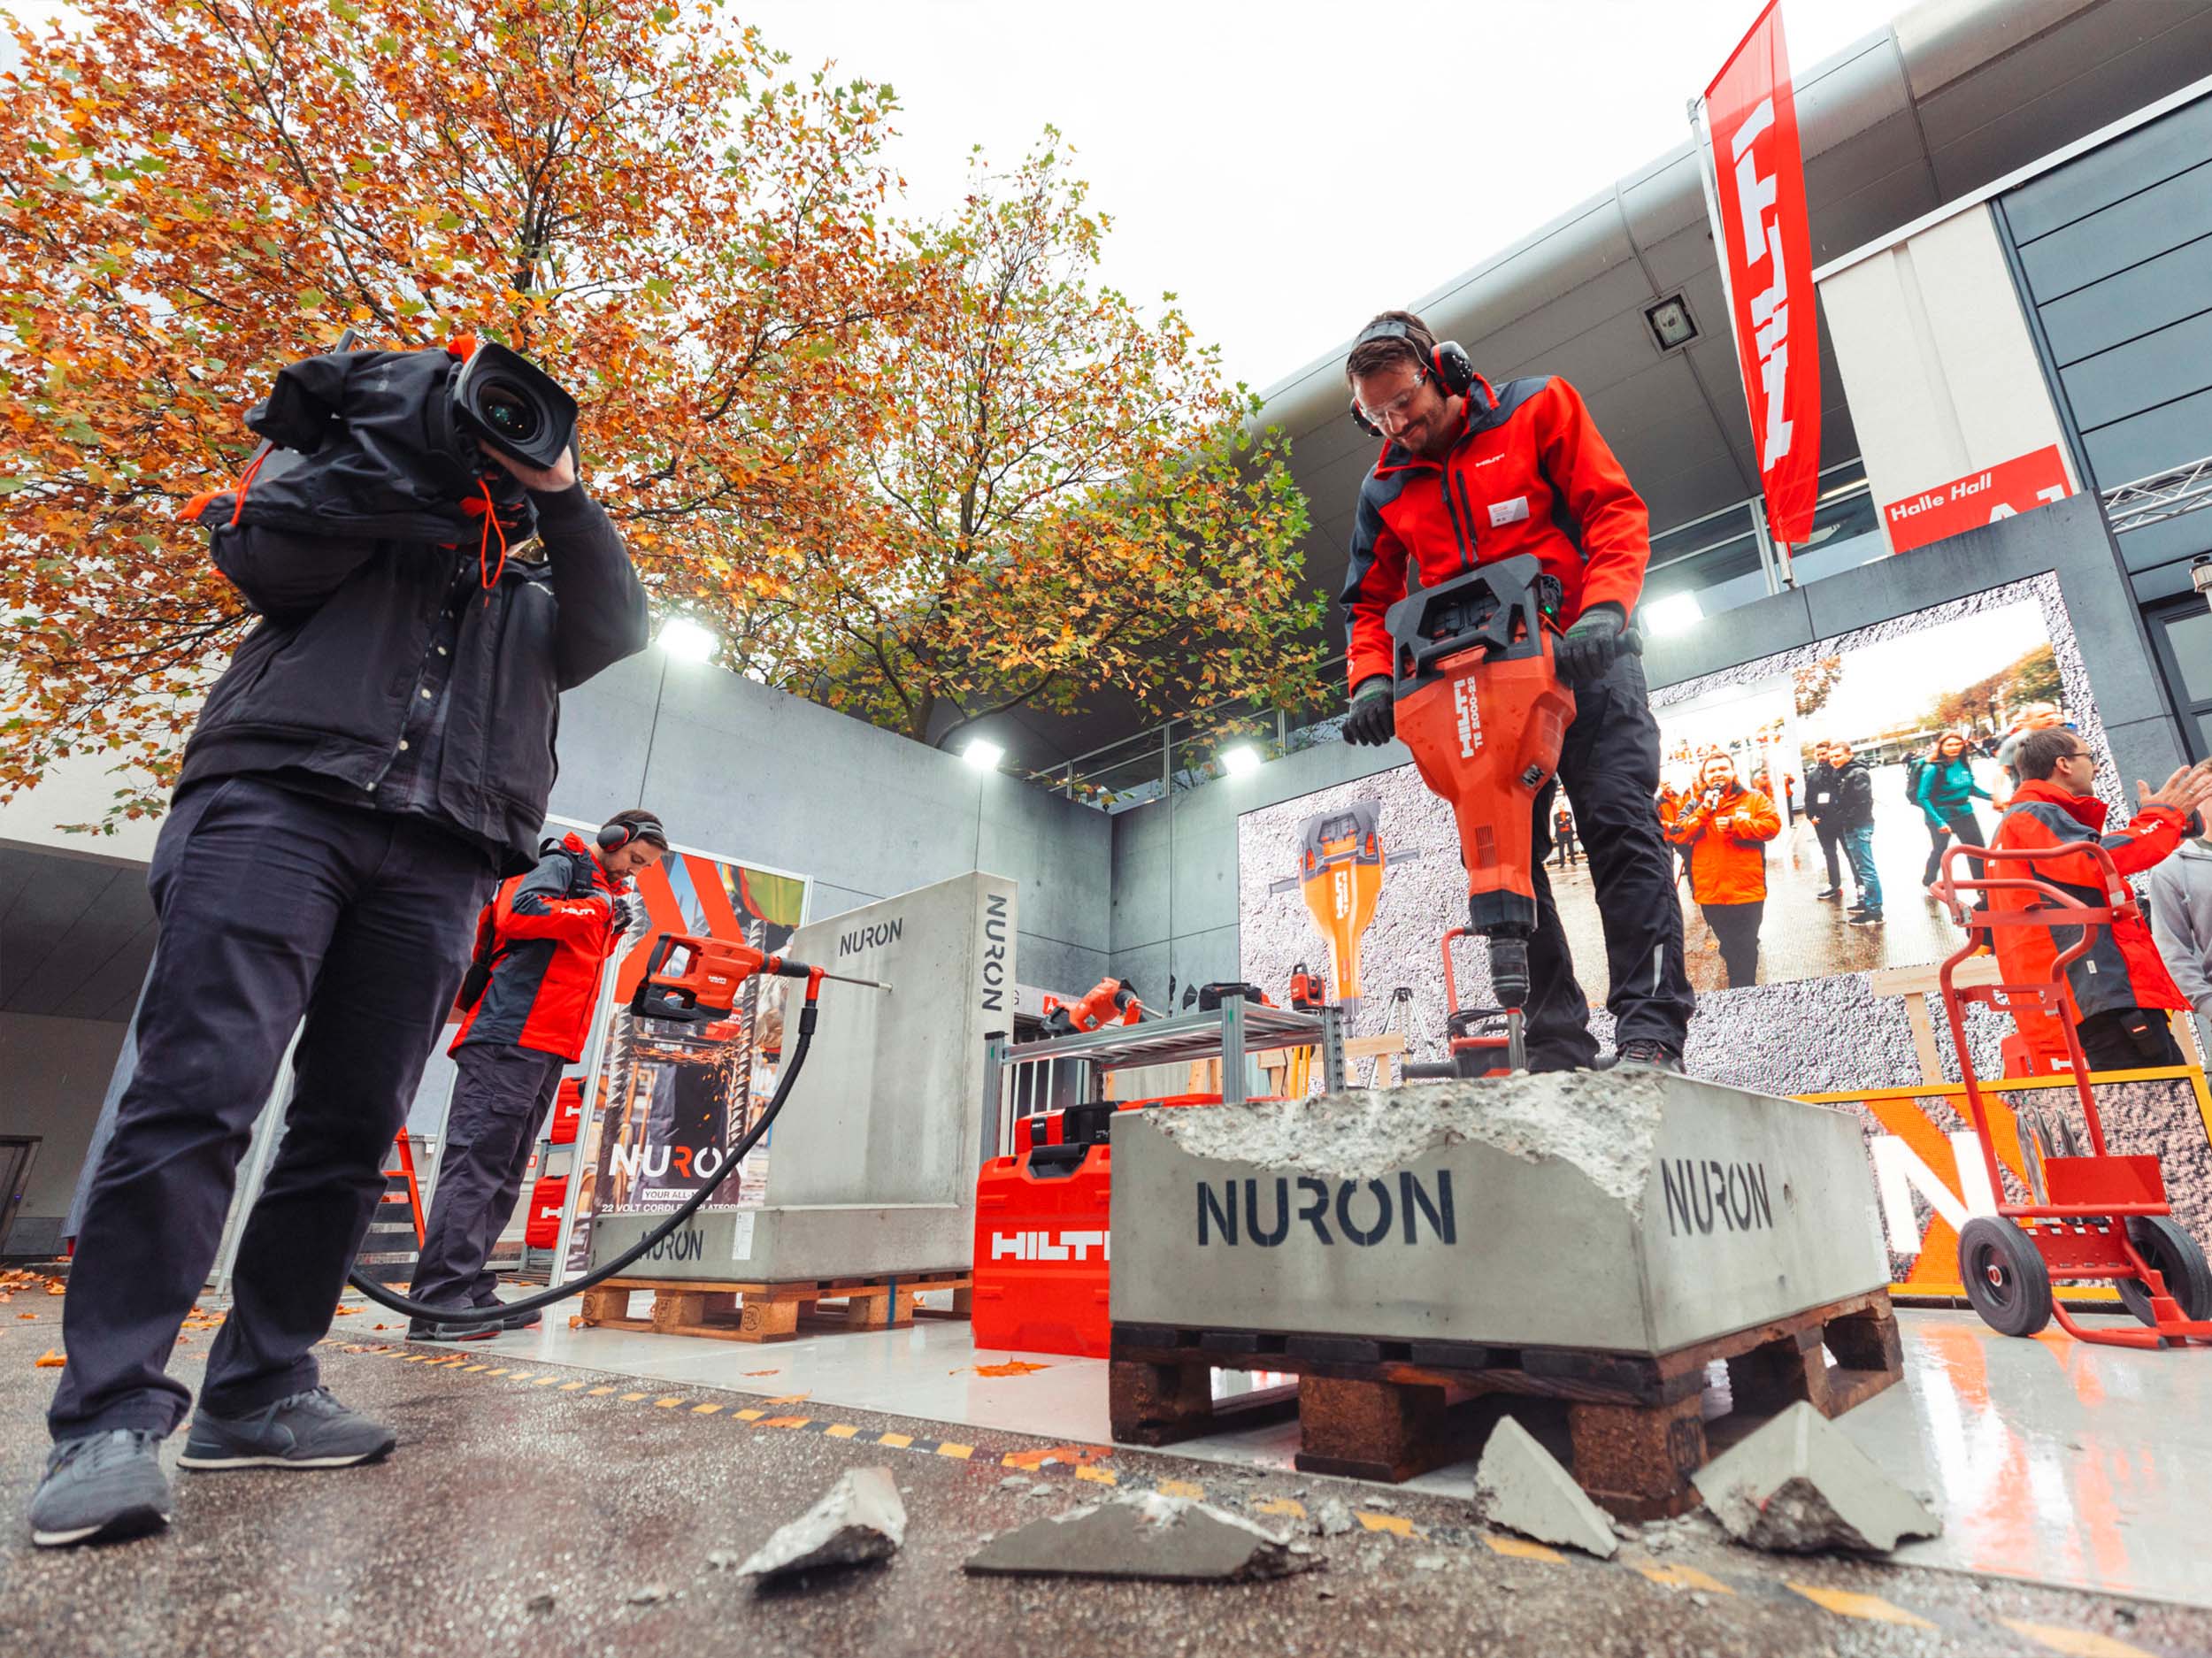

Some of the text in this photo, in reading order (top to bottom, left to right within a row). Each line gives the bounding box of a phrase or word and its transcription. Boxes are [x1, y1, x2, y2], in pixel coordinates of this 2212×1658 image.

[1731, 98, 1793, 472] HILTI
[1890, 472, 1992, 522] Halle Hall
[1454, 679, 1474, 758] HILTI
[1467, 676, 1483, 749] TE 2000-22
[840, 917, 902, 956] NURON
[981, 894, 1007, 1011] NURON
[602, 1204, 614, 1213] 22
[617, 1204, 642, 1213] VOLT
[643, 1204, 681, 1213] CORDLE
[645, 1189, 671, 1198] YOUR
[1197, 1170, 1456, 1247] NURON
[1661, 1158, 1772, 1236] NURON
[991, 1230, 1110, 1261] HILTI
